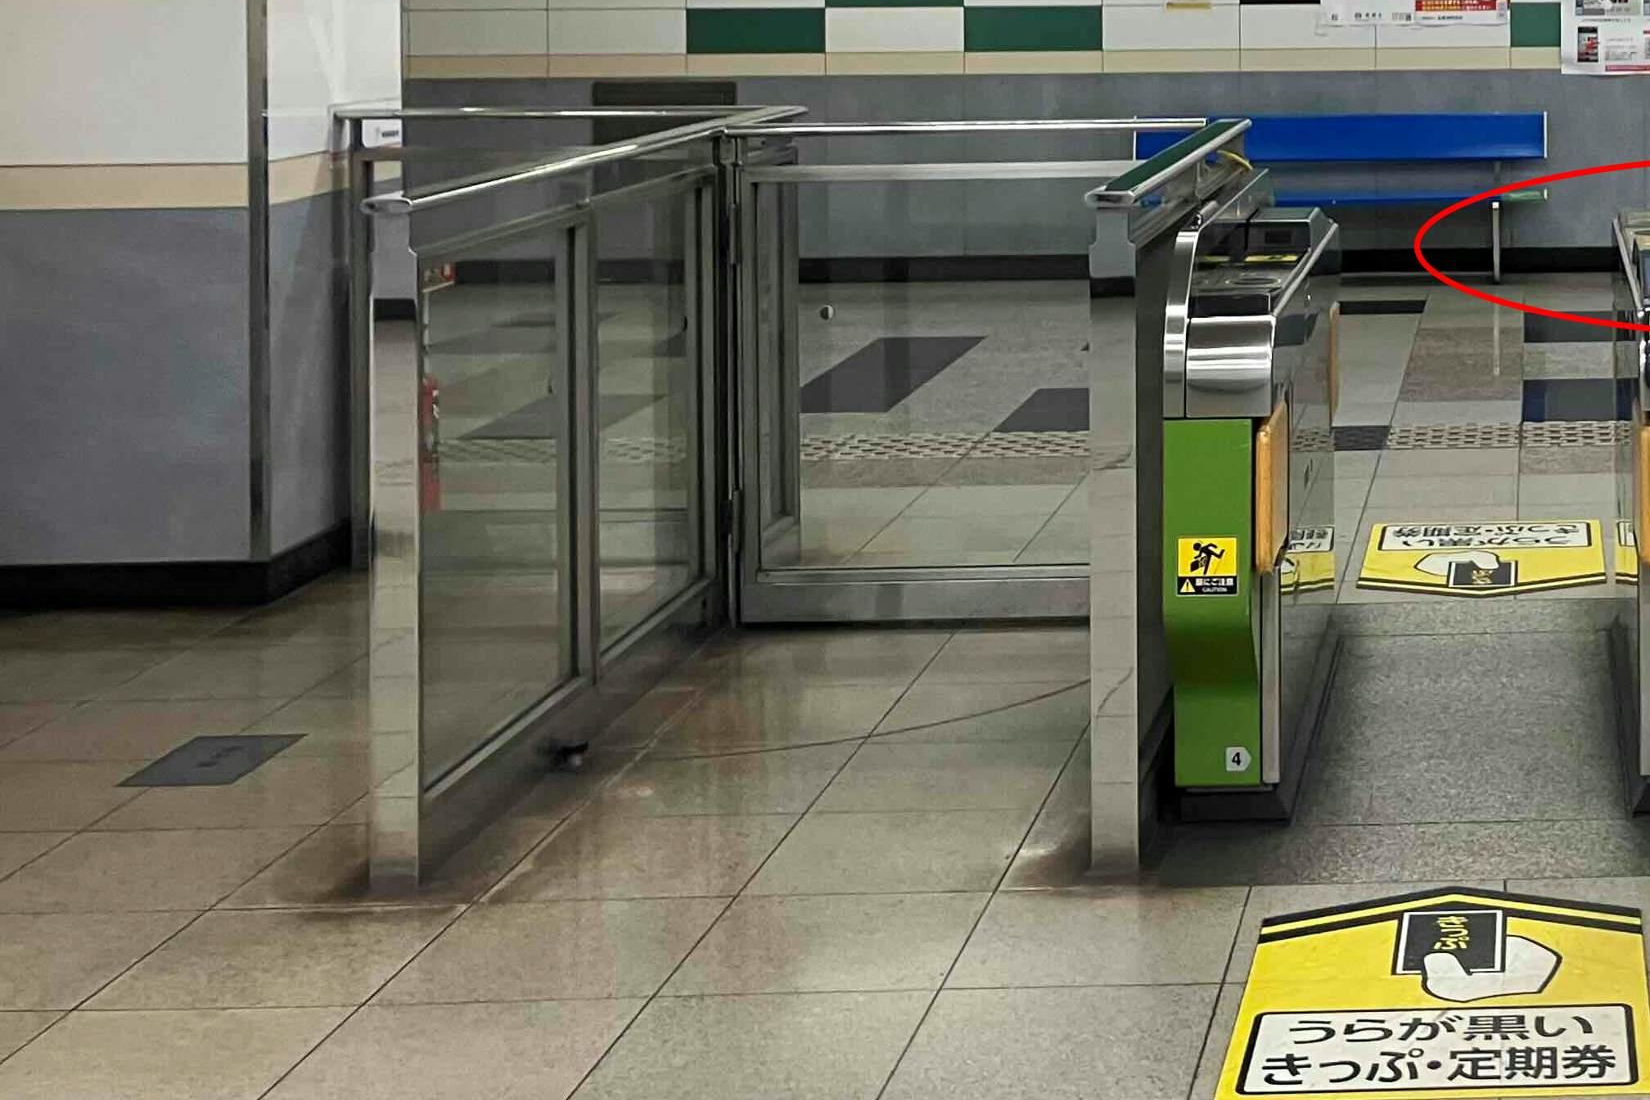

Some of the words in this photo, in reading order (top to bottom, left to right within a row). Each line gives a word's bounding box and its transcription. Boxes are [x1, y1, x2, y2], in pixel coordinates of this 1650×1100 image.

[1231, 751, 1242, 767] 4
[1433, 915, 1470, 950] きっぷ
[1288, 1014, 1595, 1045] うらが黒い
[1261, 1043, 1617, 1087] きっぷ・定期券
